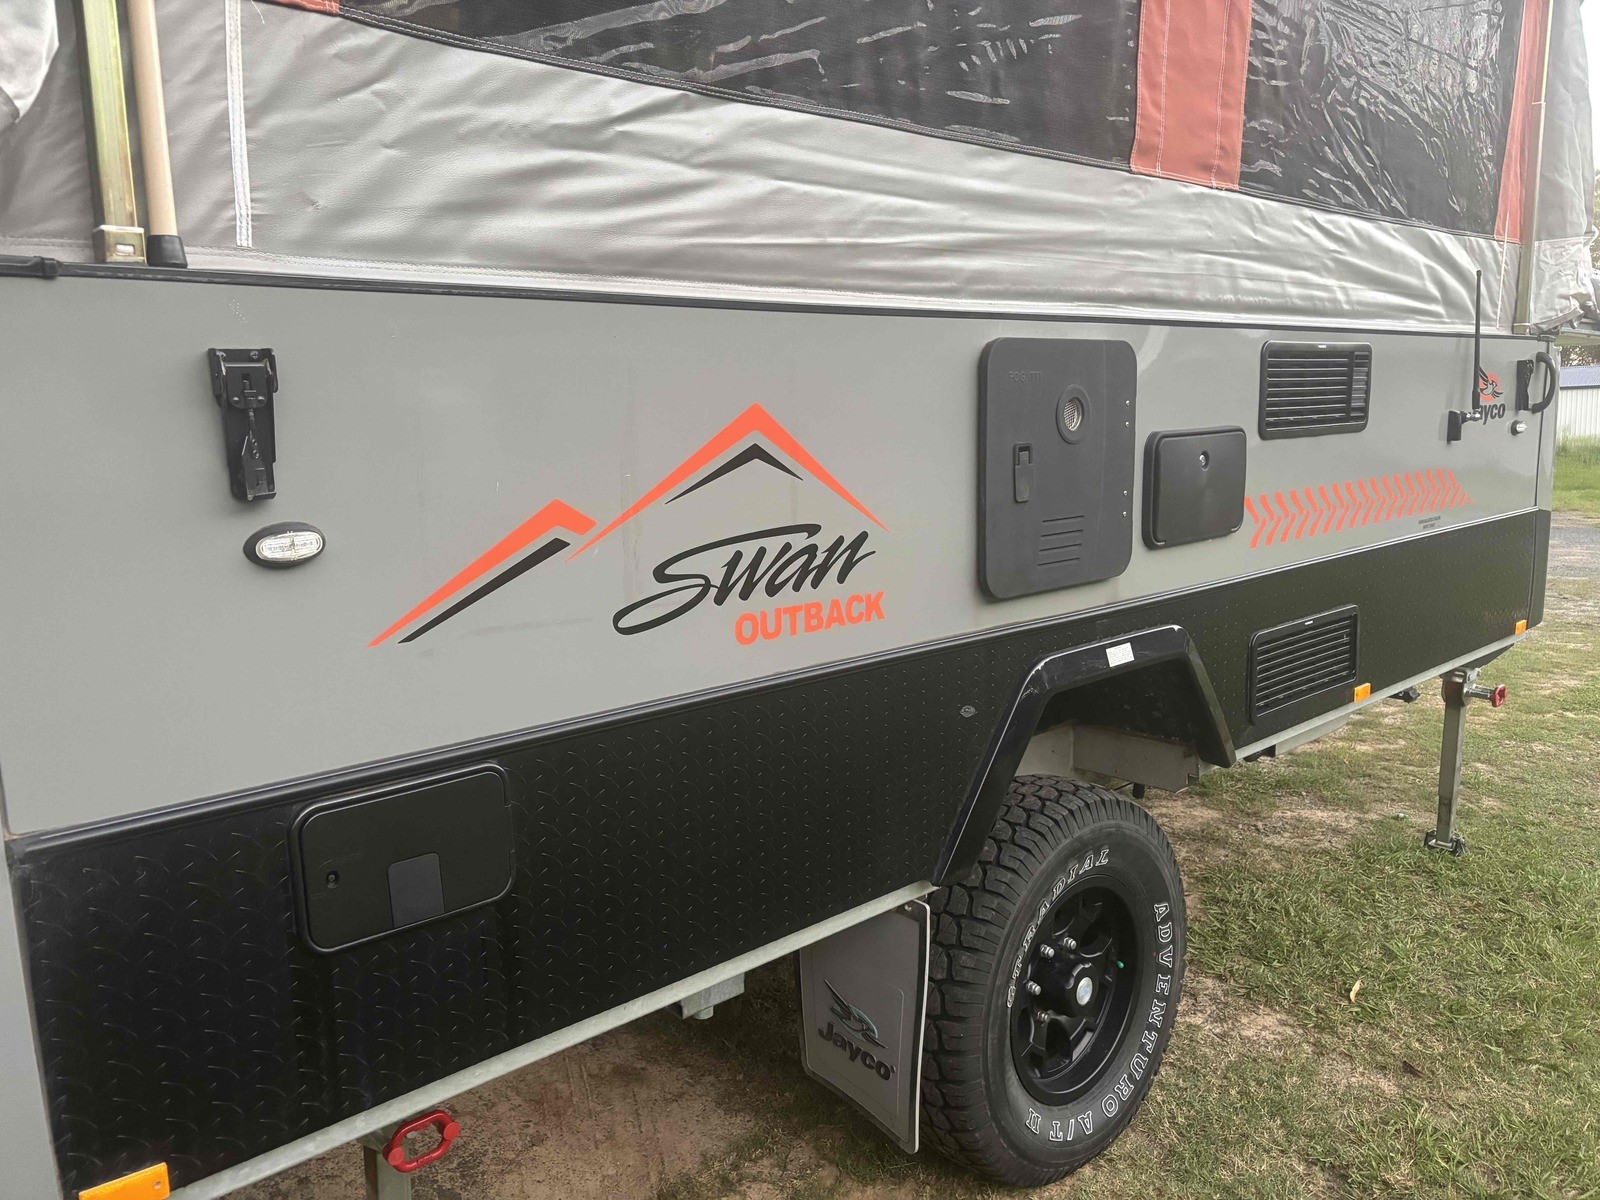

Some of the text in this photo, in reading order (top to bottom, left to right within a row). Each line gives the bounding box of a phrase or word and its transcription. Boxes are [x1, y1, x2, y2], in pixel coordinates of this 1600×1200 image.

[1008, 370, 1042, 383] FOGATTI
[1477, 403, 1506, 426] ayco
[612, 523, 877, 636] Swan
[734, 591, 886, 646] OUTBACK
[1101, 902, 1174, 1118] ADVENTURO
[817, 1021, 893, 1081] Jayco
